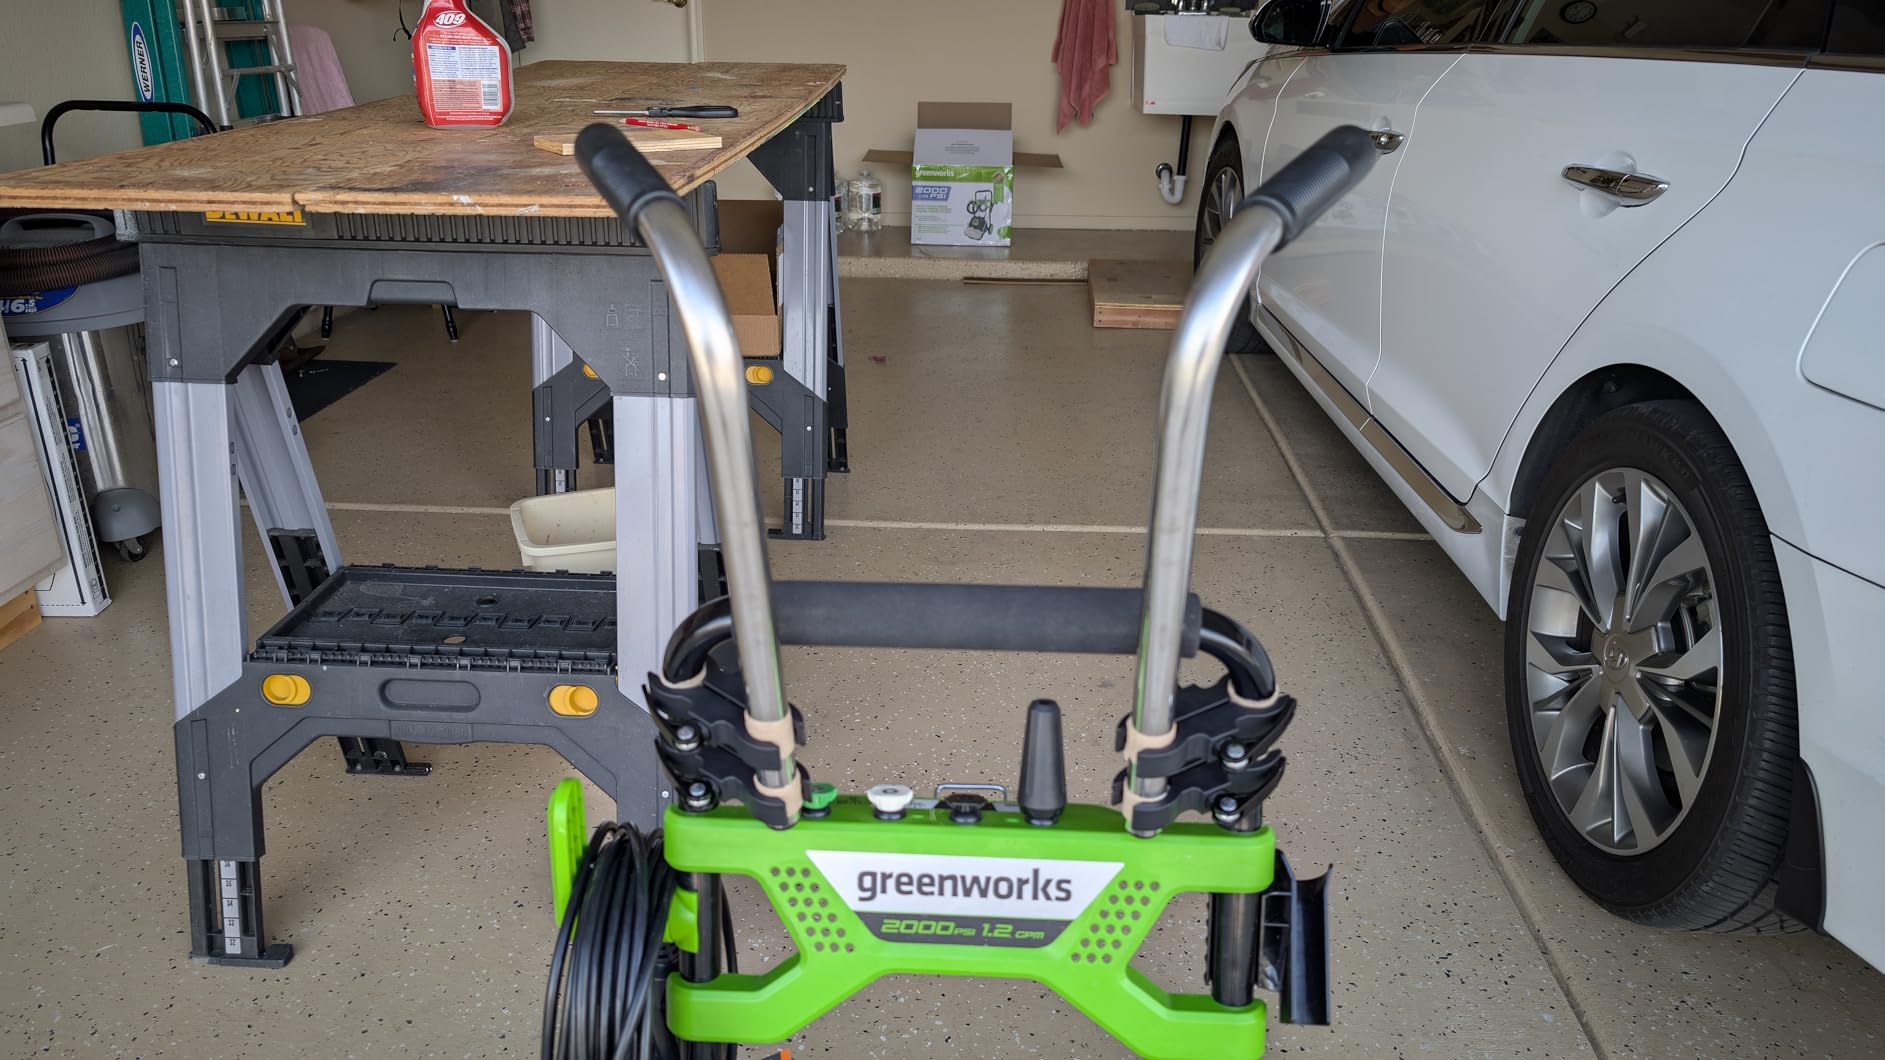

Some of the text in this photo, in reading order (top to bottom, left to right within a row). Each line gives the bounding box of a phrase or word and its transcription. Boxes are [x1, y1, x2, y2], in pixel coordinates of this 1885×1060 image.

[435, 13, 466, 25] 409
[136, 41, 150, 92] WERNER
[857, 868, 1072, 902] greenworks
[981, 923, 1013, 938] 1.2
[1015, 930, 1045, 940] GPM
[229, 938, 236, 946] 32
